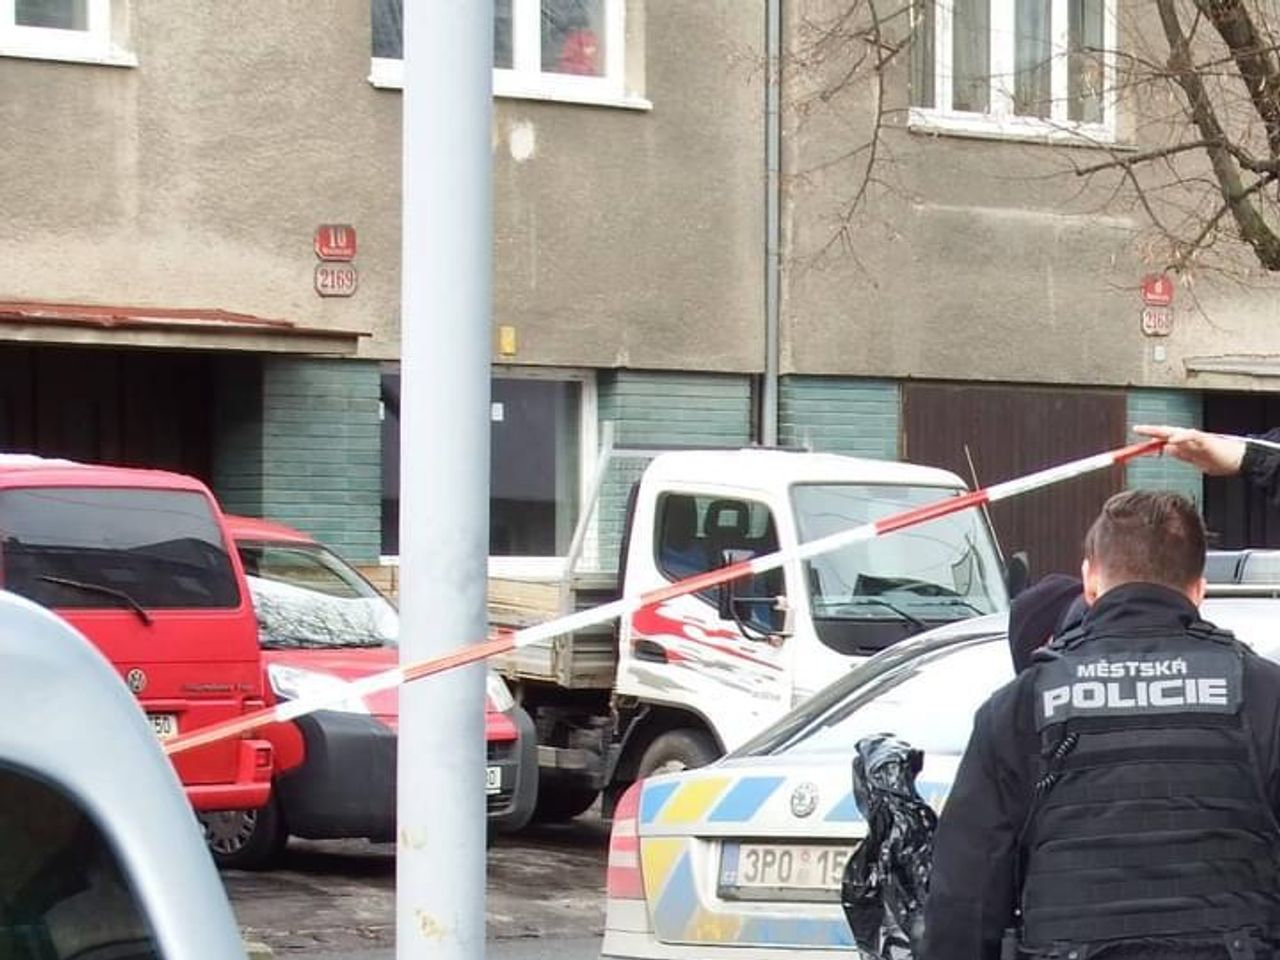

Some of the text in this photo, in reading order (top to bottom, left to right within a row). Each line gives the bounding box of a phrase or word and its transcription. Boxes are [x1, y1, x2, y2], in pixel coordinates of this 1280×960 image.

[320, 268, 353, 289] 2169
[1077, 657, 1188, 678] MĚSTSKÁ
[1043, 678, 1229, 718] POLICIE
